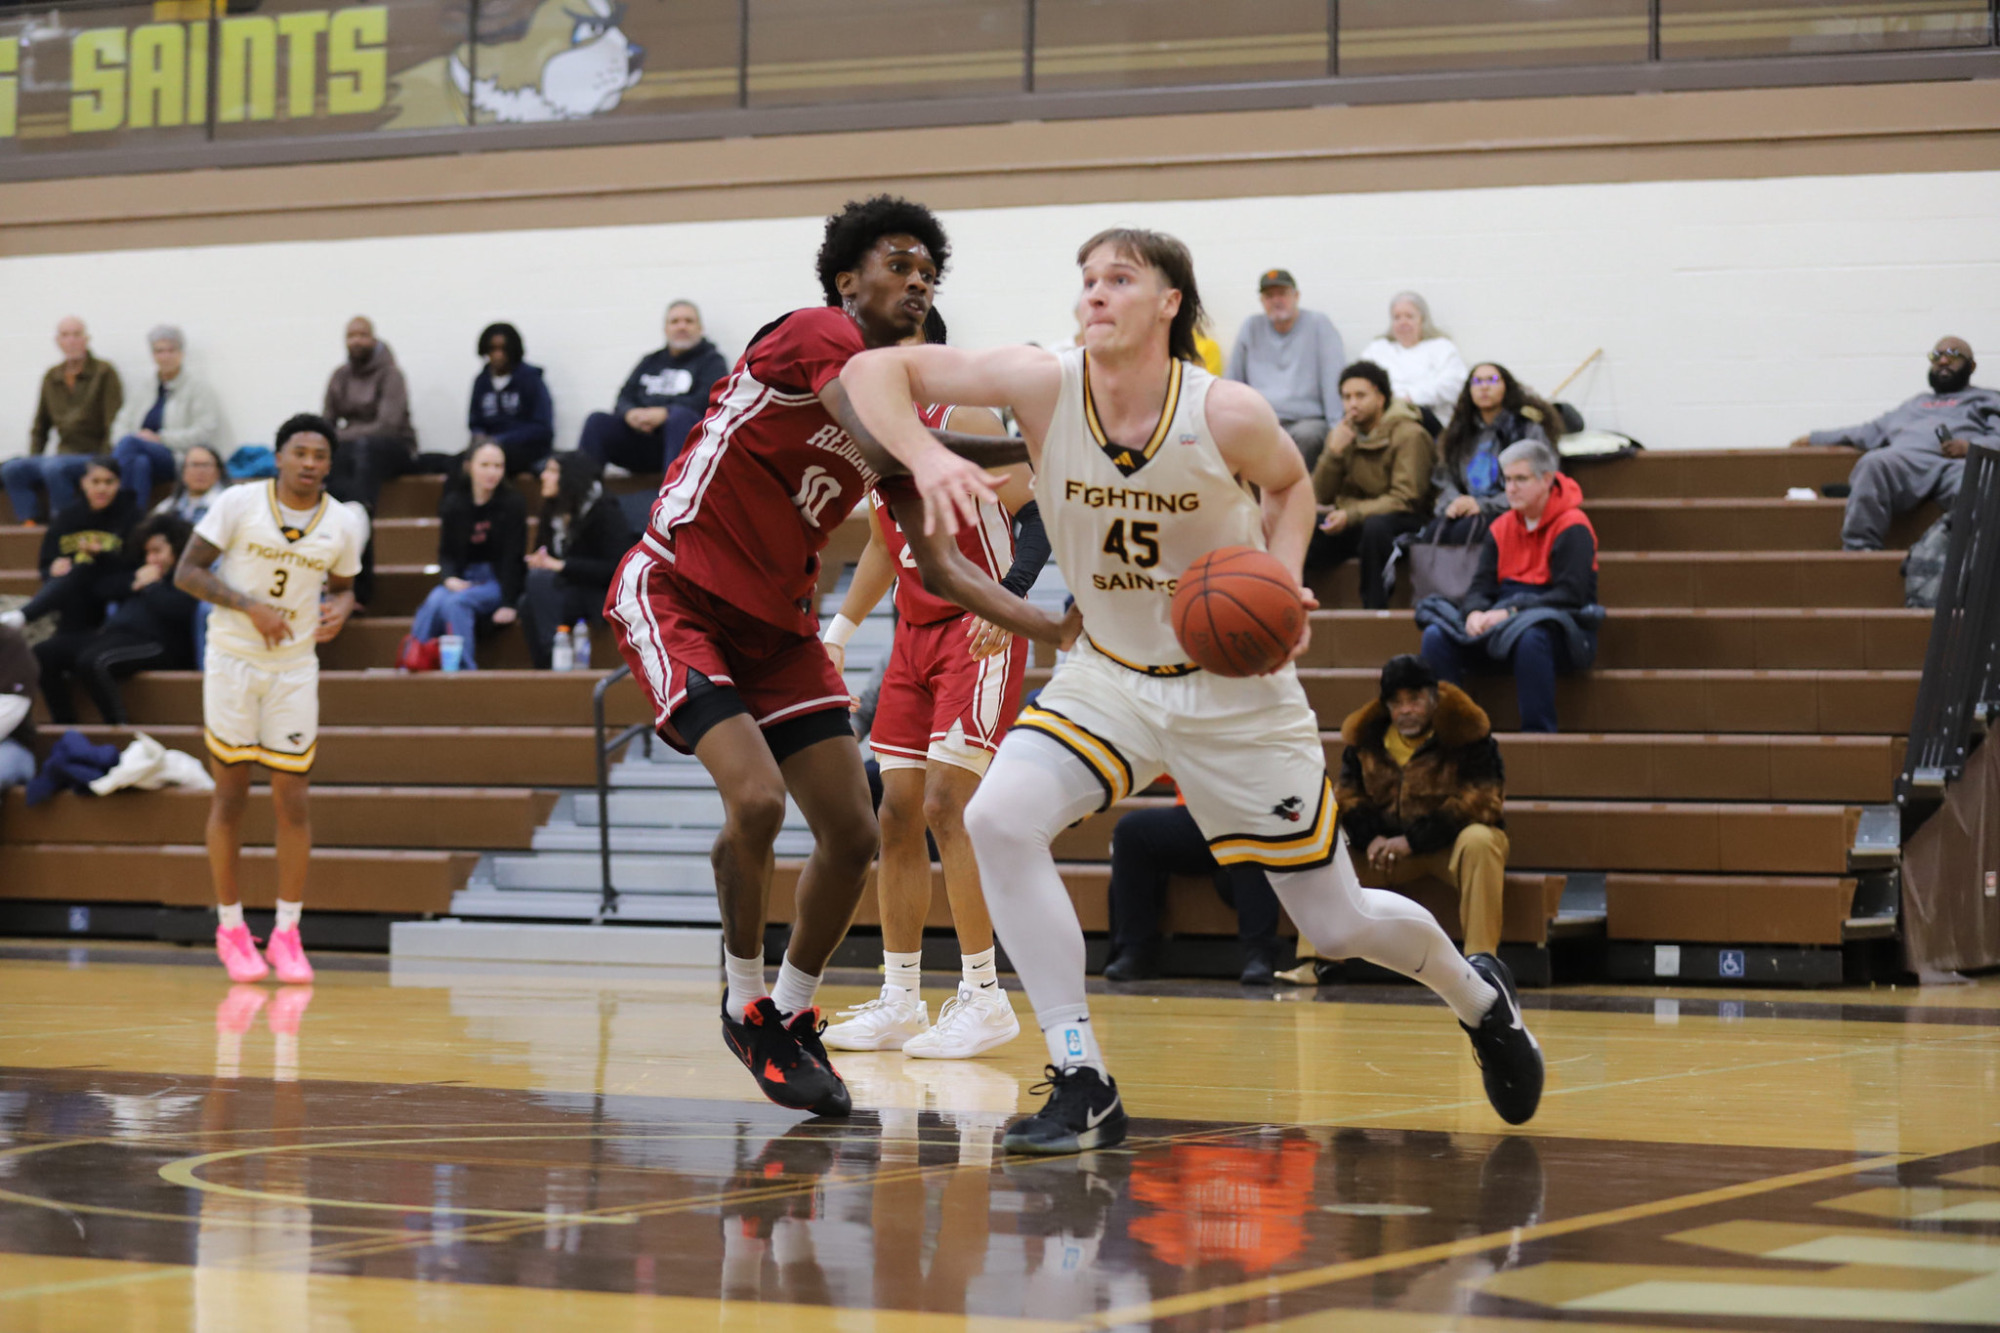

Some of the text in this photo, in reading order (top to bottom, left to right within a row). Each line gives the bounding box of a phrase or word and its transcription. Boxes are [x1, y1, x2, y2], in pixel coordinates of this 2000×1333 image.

[71, 6, 388, 133] SAINTS
[791, 465, 842, 527] 10
[1065, 480, 1199, 513] FIGHTING
[1103, 518, 1160, 568] 45
[269, 568, 288, 598] 3
